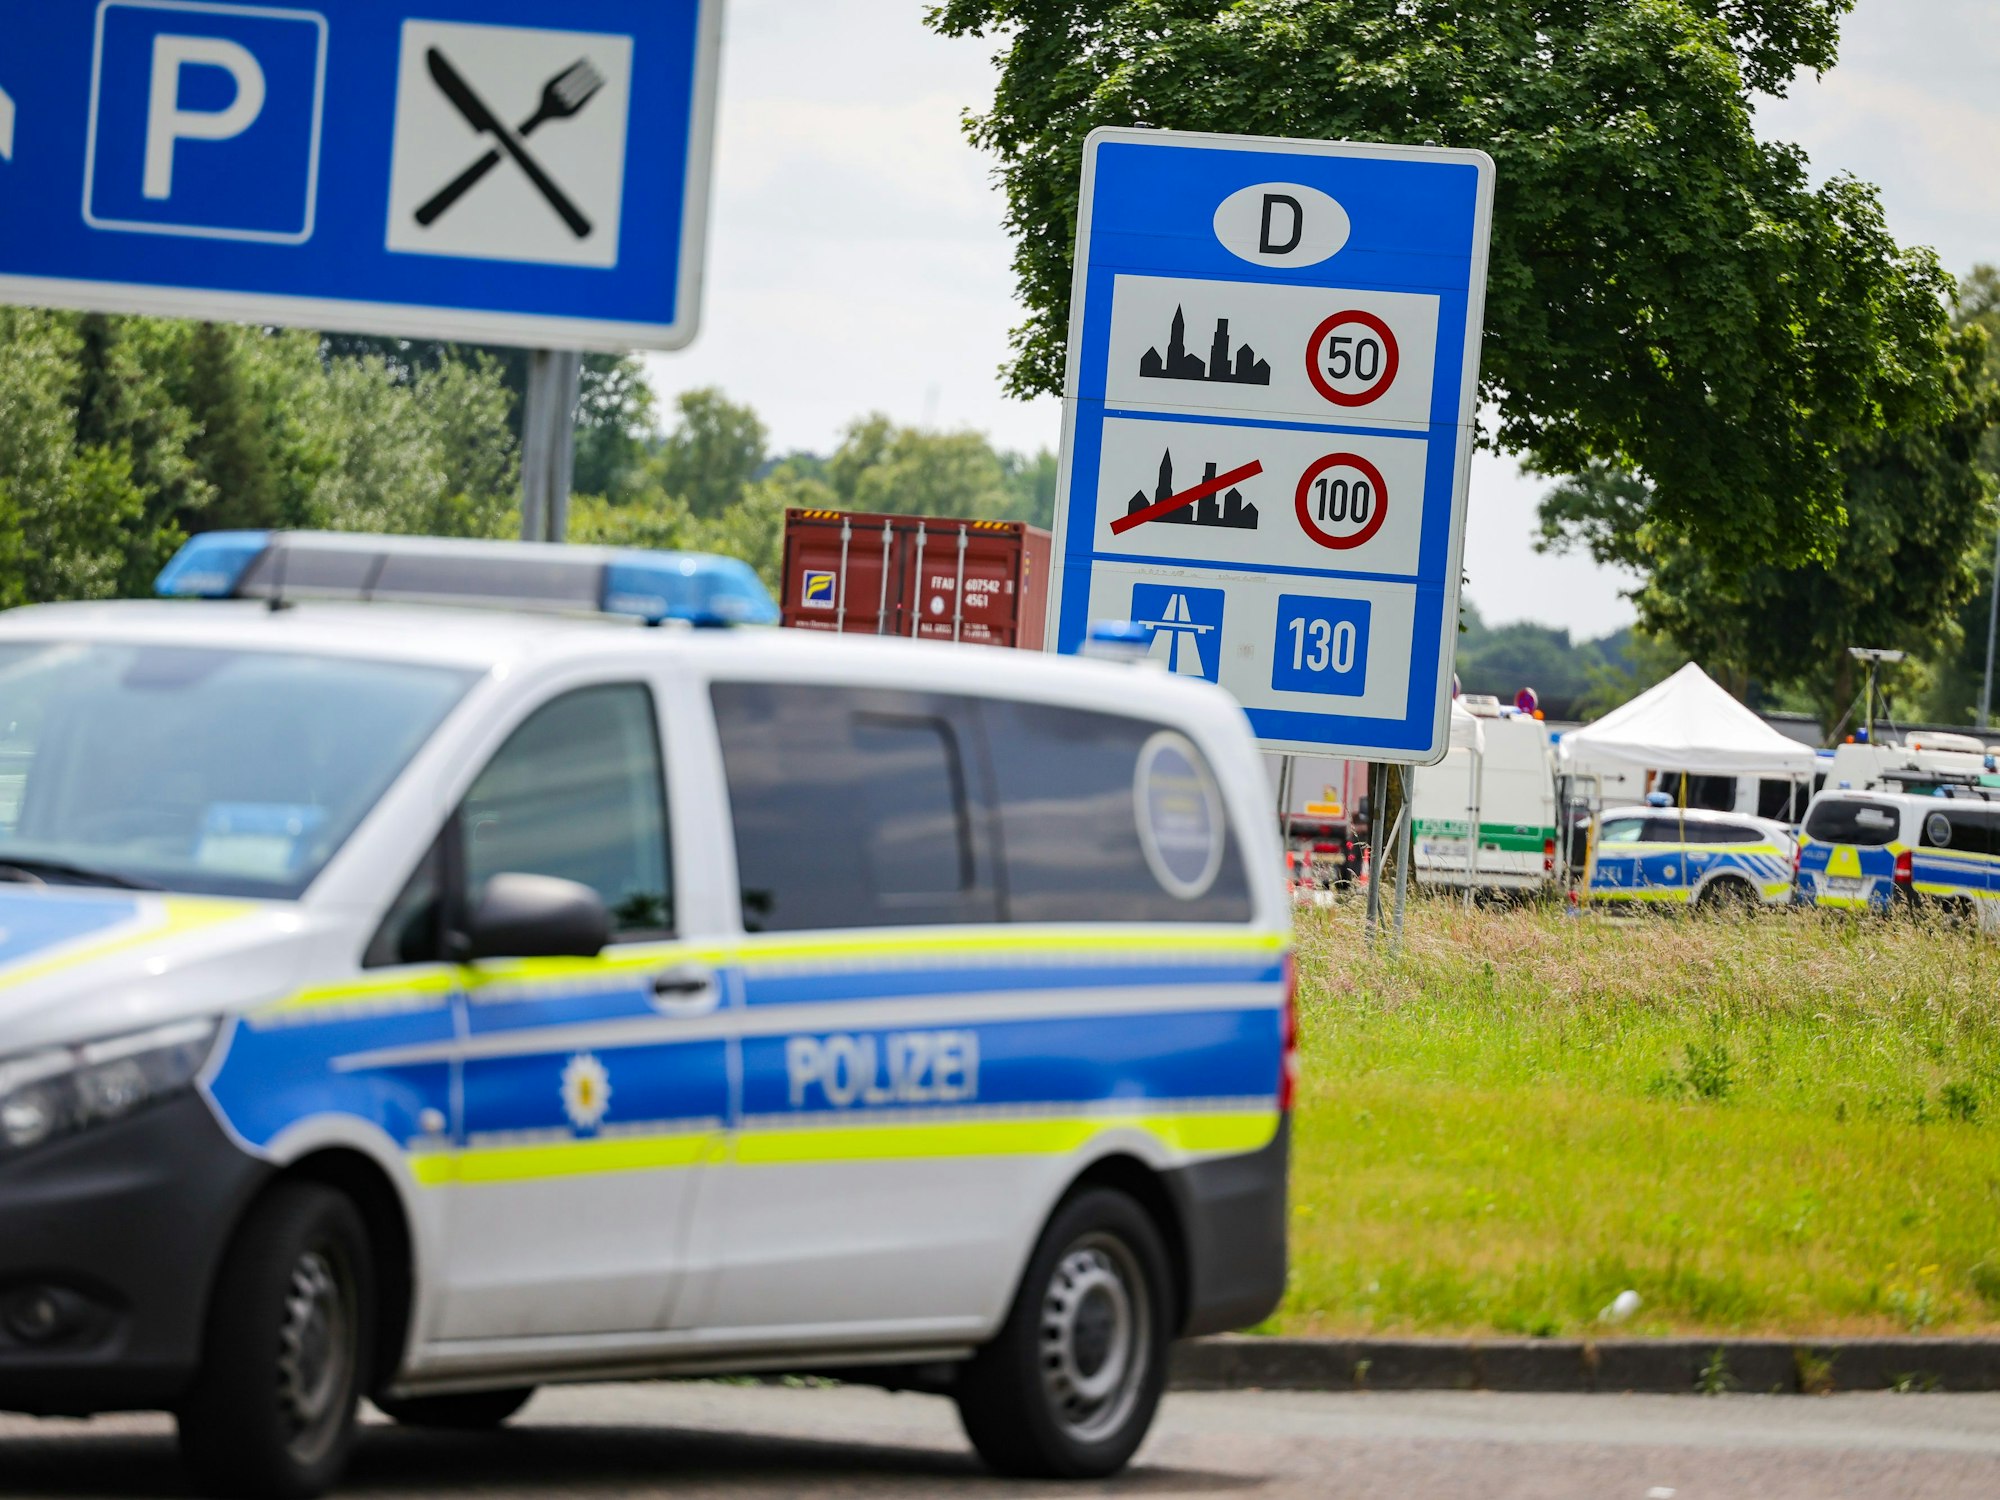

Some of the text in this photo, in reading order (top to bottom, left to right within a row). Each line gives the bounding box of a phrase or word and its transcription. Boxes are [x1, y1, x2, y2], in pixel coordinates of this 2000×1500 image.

[143, 33, 266, 200] P
[1259, 194, 1303, 254] D
[1327, 336, 1379, 381] 50
[1315, 478, 1370, 523] 100
[930, 576, 955, 591] FFAU
[964, 578, 1000, 594] 607542
[965, 593, 988, 608] 45G1
[1289, 617, 1356, 674] 130
[785, 1029, 979, 1107] POLIZEI
